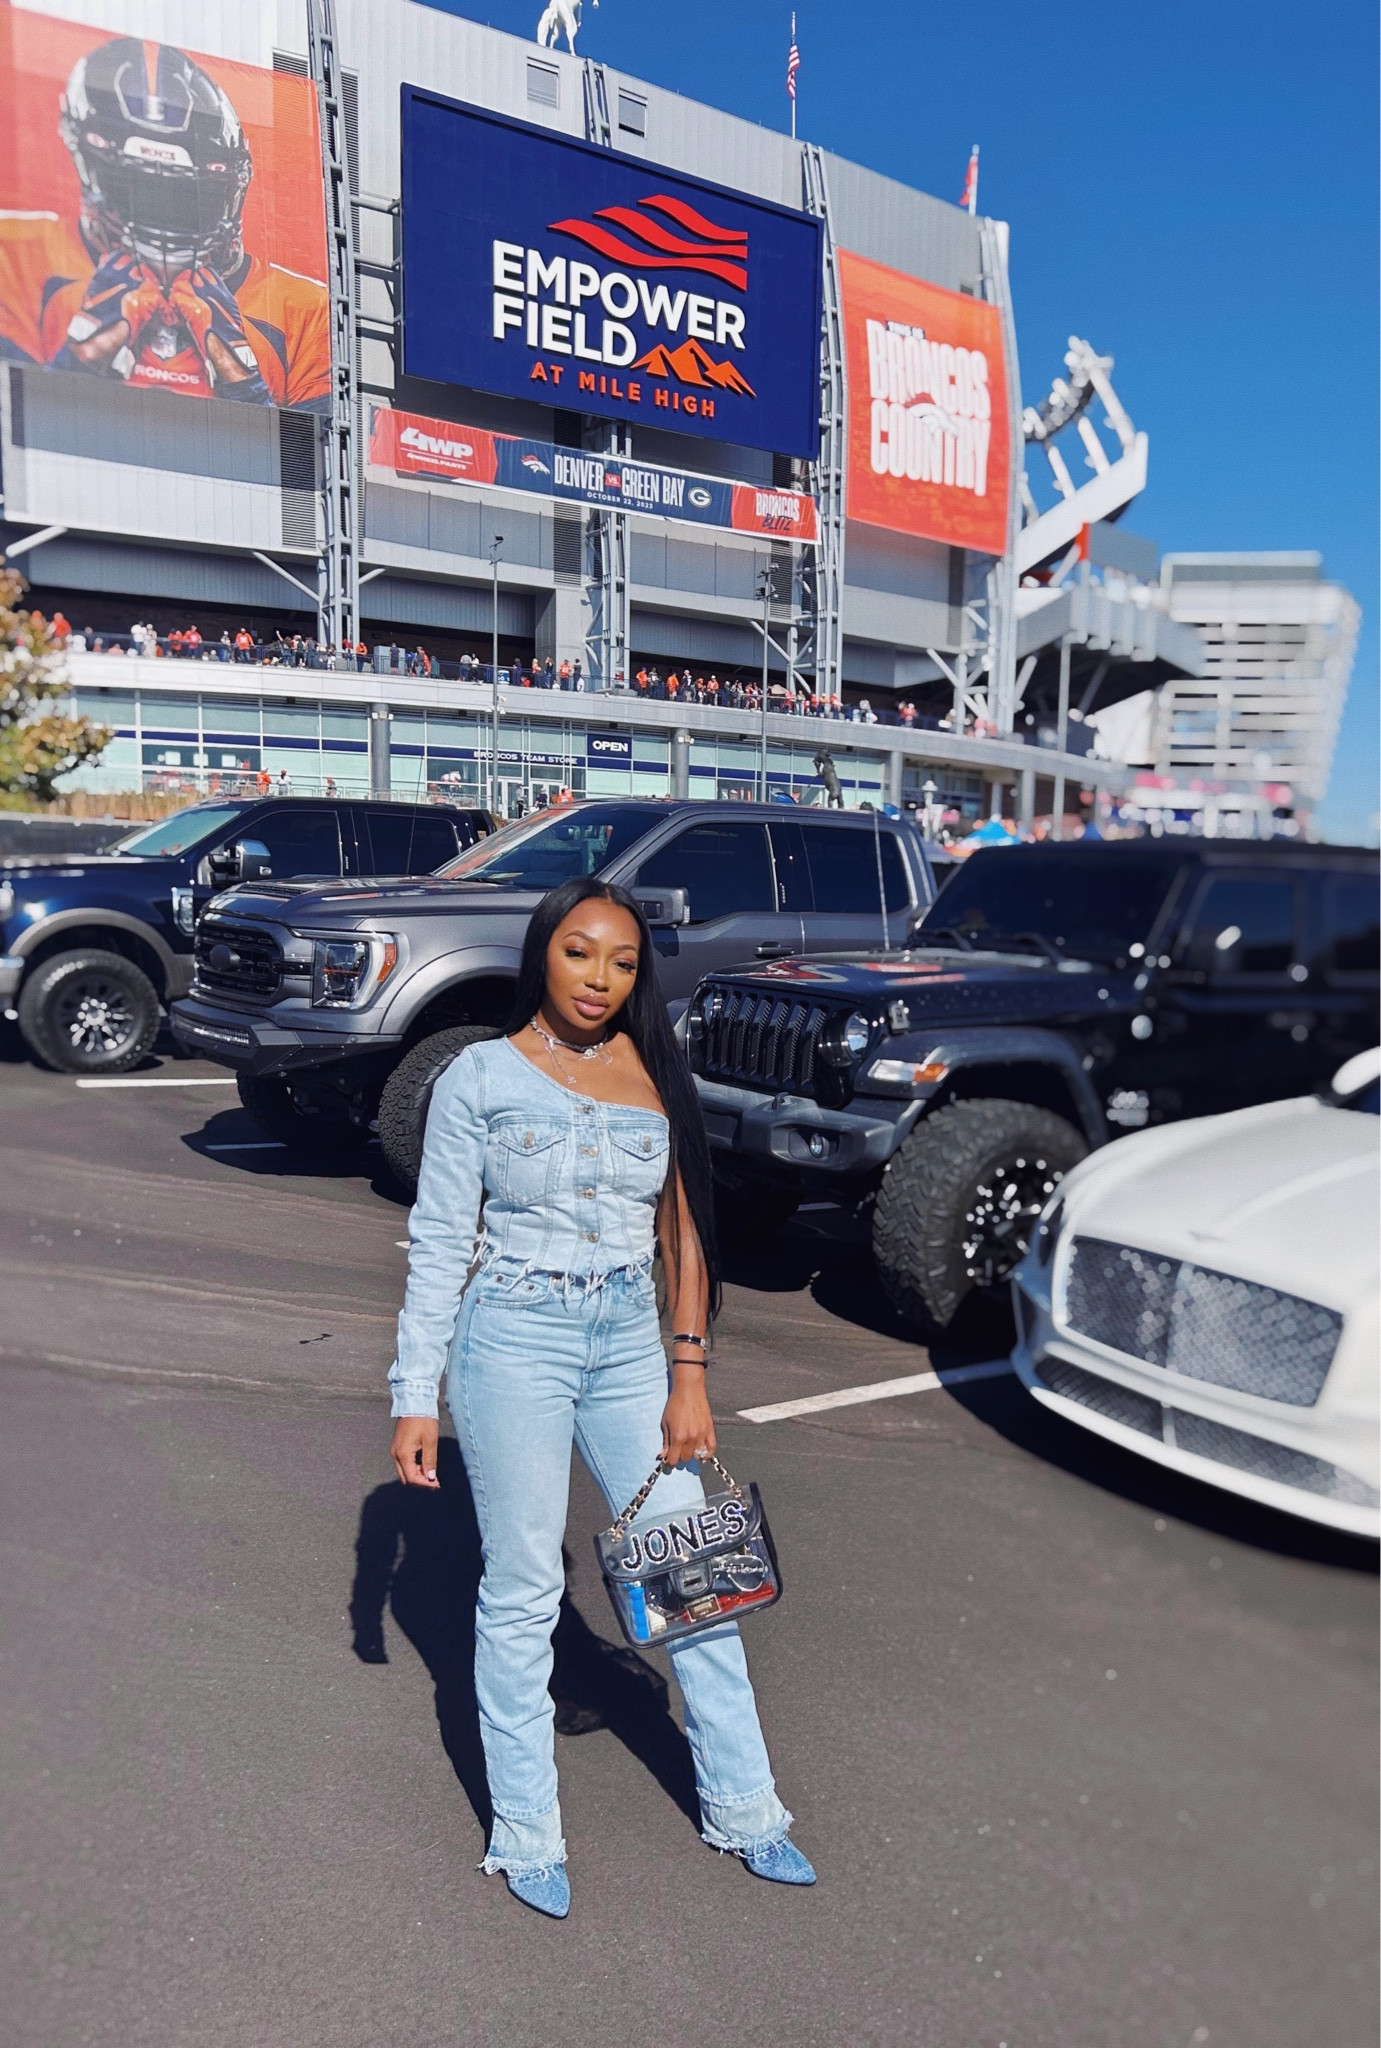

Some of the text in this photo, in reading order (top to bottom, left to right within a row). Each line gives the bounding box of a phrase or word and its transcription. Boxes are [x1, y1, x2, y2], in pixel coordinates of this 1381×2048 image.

[493, 239, 746, 350] EMPOWER
[493, 292, 638, 367] FIELD
[531, 361, 716, 419] AT MILE HIGH
[400, 427, 474, 458] 4WP
[554, 454, 605, 492] DENVER
[621, 467, 660, 503] GREEN
[662, 475, 686, 507] BAY
[586, 491, 621, 503] OCTOBER
[636, 500, 654, 509] 2023
[755, 491, 800, 523] BRONCOS
[762, 512, 794, 531] BLITZ
[473, 750, 578, 765] BROCOS TEAM STORE
[592, 740, 629, 753] OPEN
[621, 1499, 748, 1572] JONES
